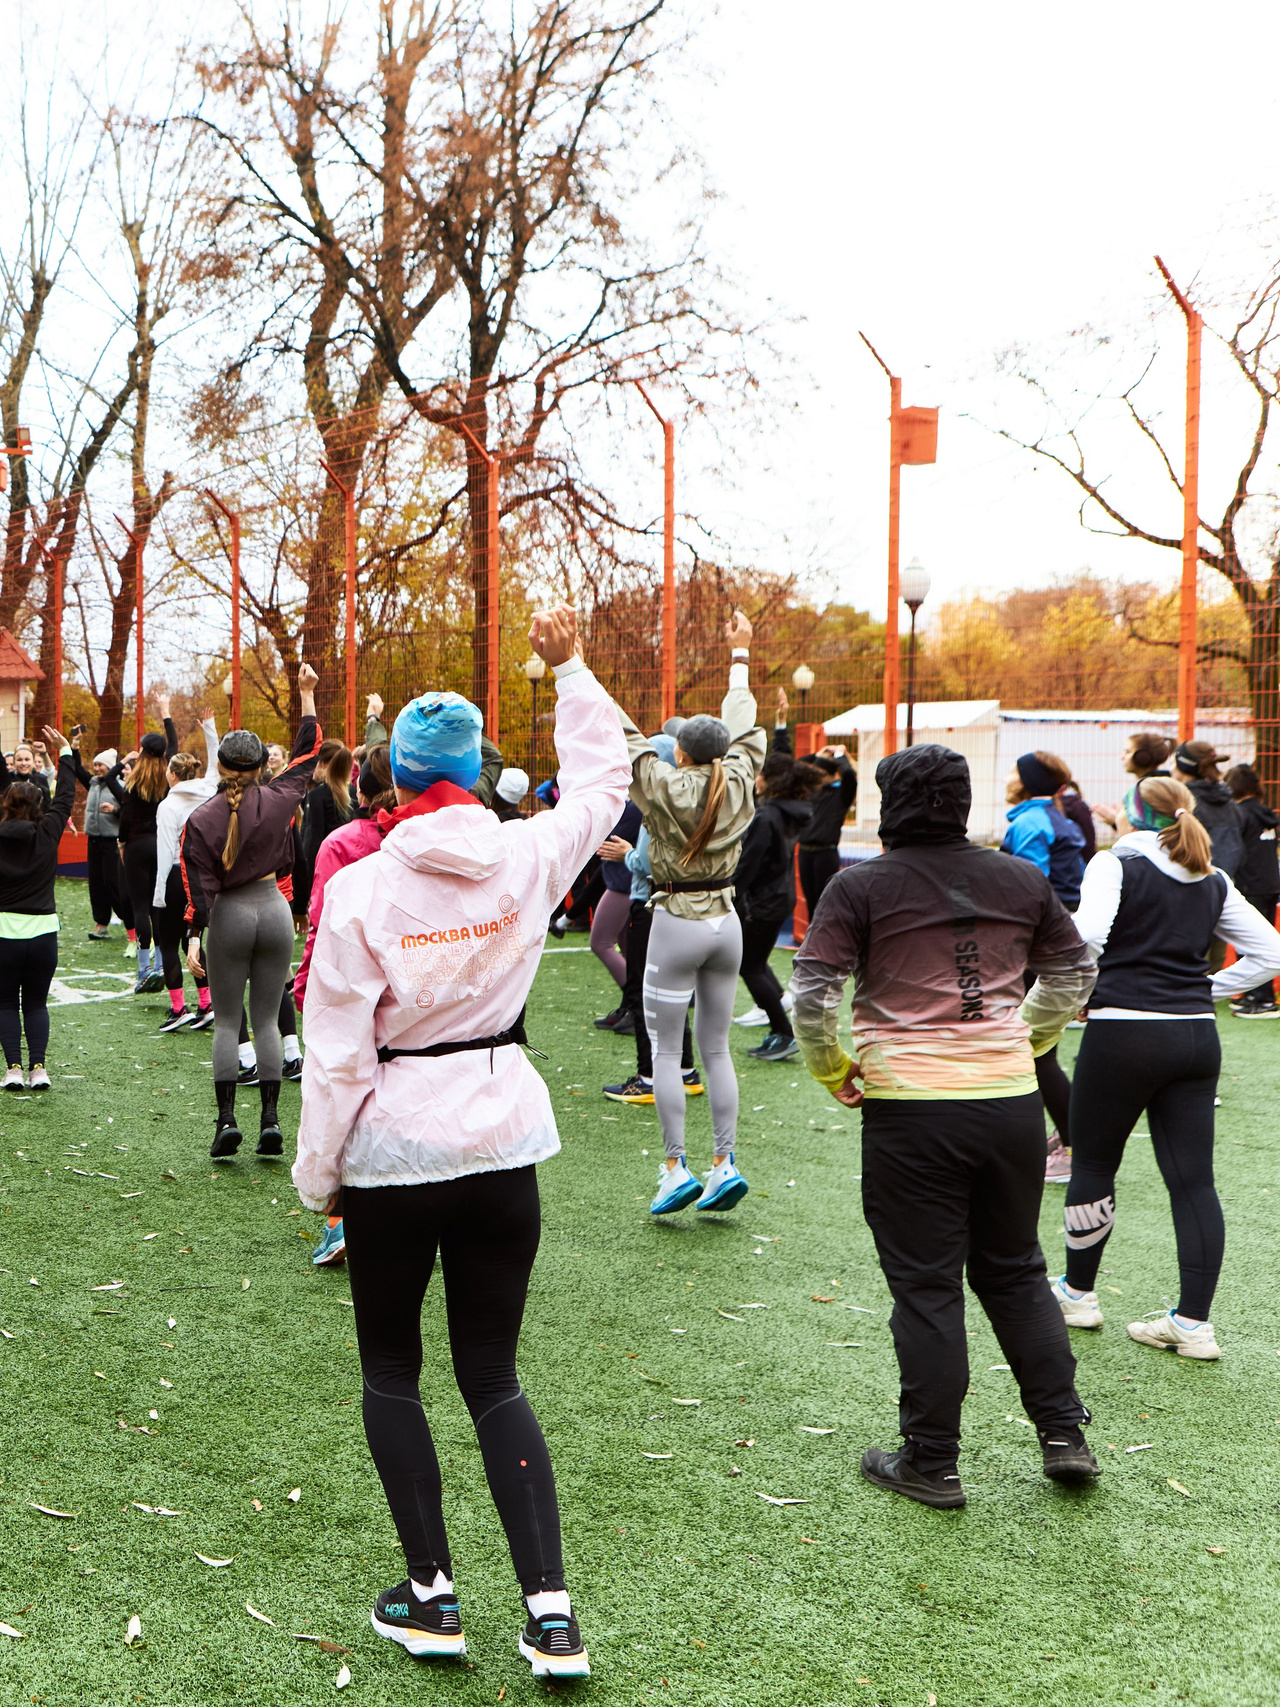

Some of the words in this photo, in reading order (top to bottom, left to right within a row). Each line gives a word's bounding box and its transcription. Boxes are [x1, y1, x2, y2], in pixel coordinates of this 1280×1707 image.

[401, 927, 471, 949] МОСКВА
[954, 940, 984, 1021] SEASONS
[1064, 1195, 1115, 1231] NIKE
[385, 1603, 409, 1617] HOKA
